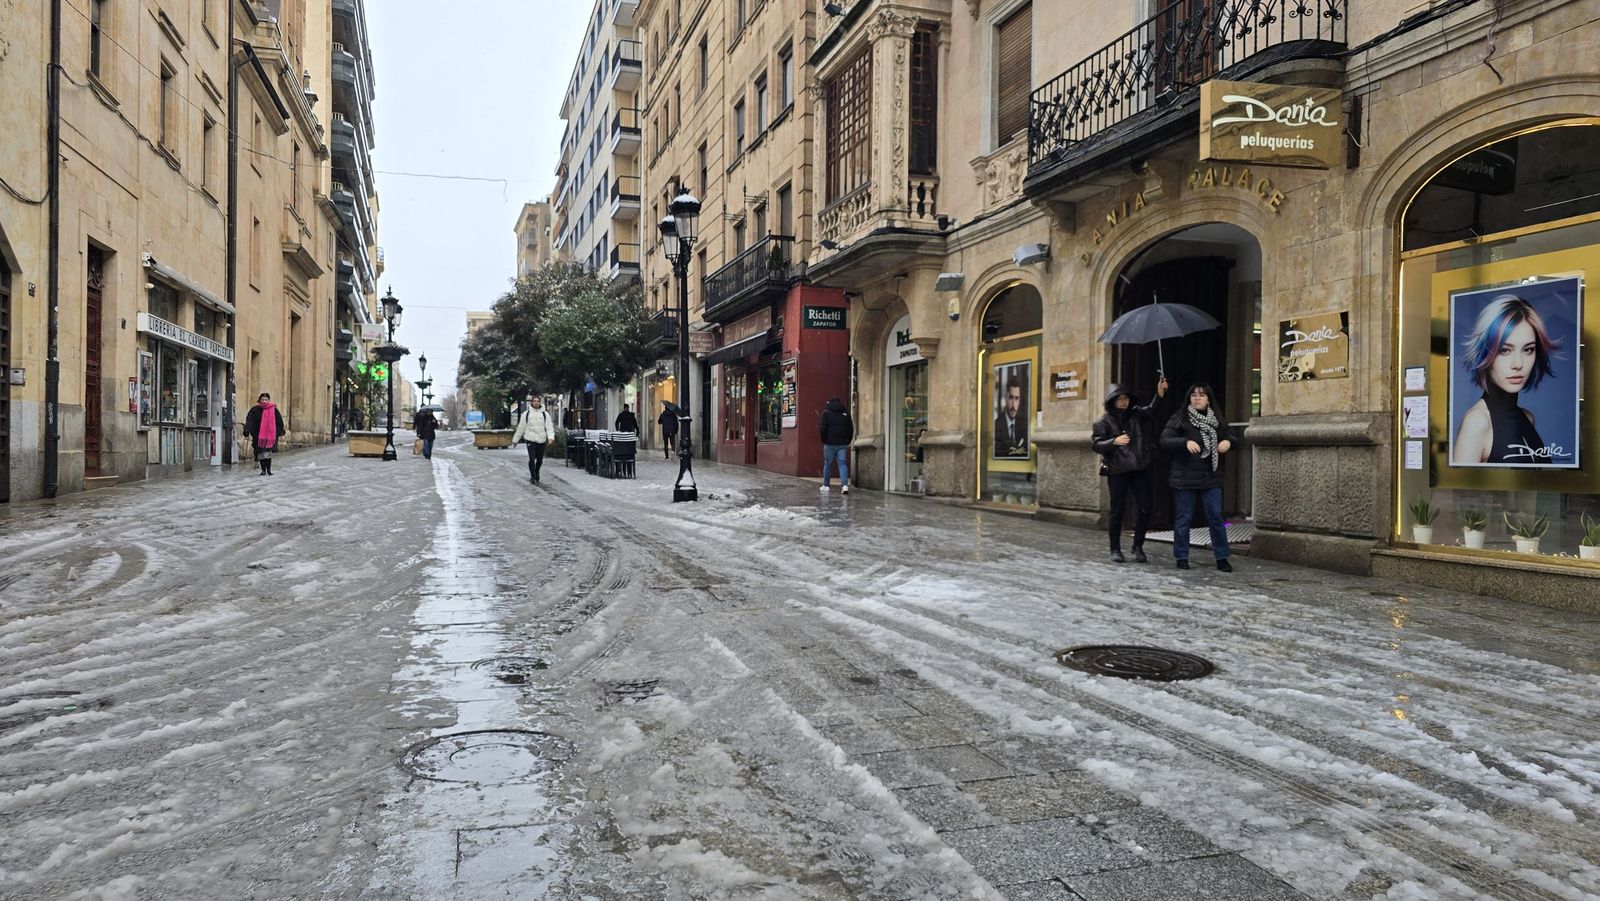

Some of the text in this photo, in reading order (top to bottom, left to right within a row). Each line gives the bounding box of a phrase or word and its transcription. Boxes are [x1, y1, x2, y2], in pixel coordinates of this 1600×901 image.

[1213, 95, 1338, 127] Dania
[1240, 131, 1314, 151] peluquerías
[1187, 166, 1286, 217] PALACE
[808, 308, 841, 320] Richetti
[188, 333, 208, 351] CARMEN
[1281, 325, 1340, 348] Dania
[1503, 442, 1572, 460] Dania
